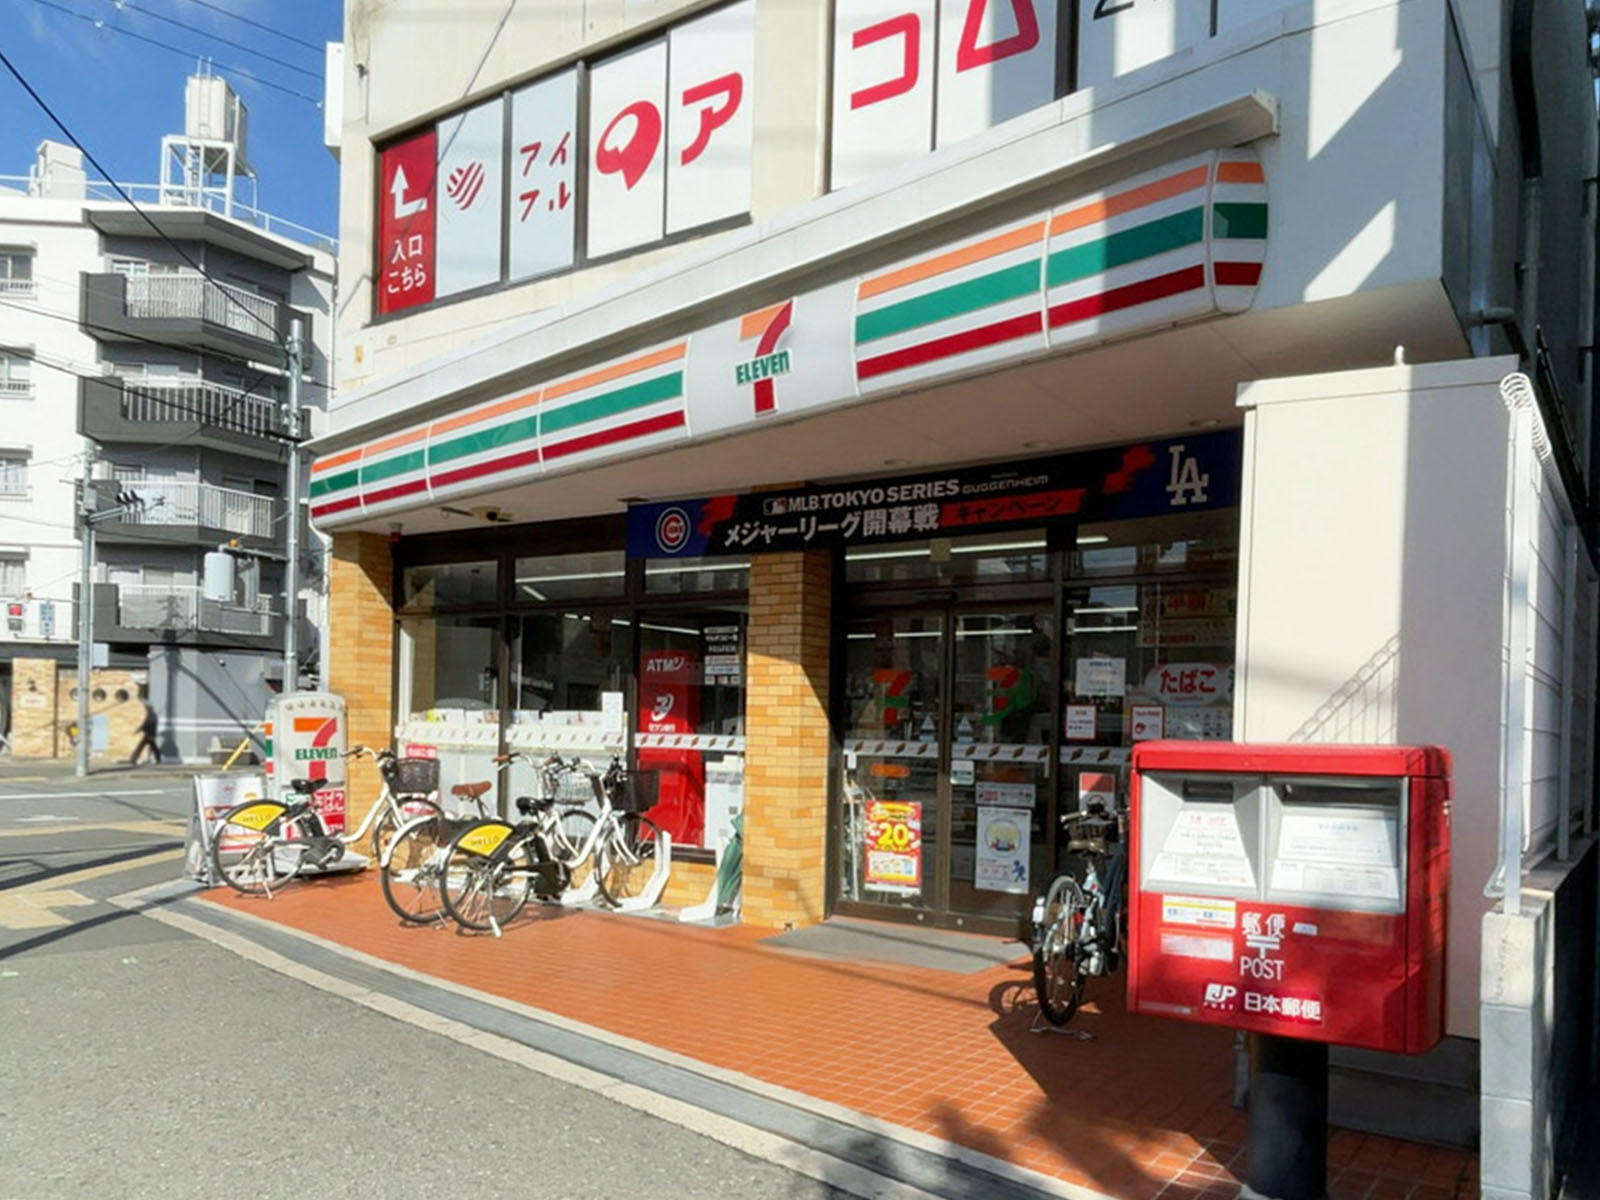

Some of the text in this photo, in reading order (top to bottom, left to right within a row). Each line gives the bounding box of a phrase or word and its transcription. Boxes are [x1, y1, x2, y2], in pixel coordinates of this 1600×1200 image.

[391, 234, 423, 263] 入口
[387, 263, 427, 293] こちら
[1166, 444, 1209, 505] LA
[886, 479, 961, 503] SERIES
[723, 502, 940, 547] メジャーリーグ開幕戦
[647, 657, 678, 672] ATM
[1160, 668, 1216, 694] たばこ
[1241, 911, 1286, 939] 郵便
[1240, 955, 1285, 981] POST
[1244, 991, 1322, 1021] 日本郵便
